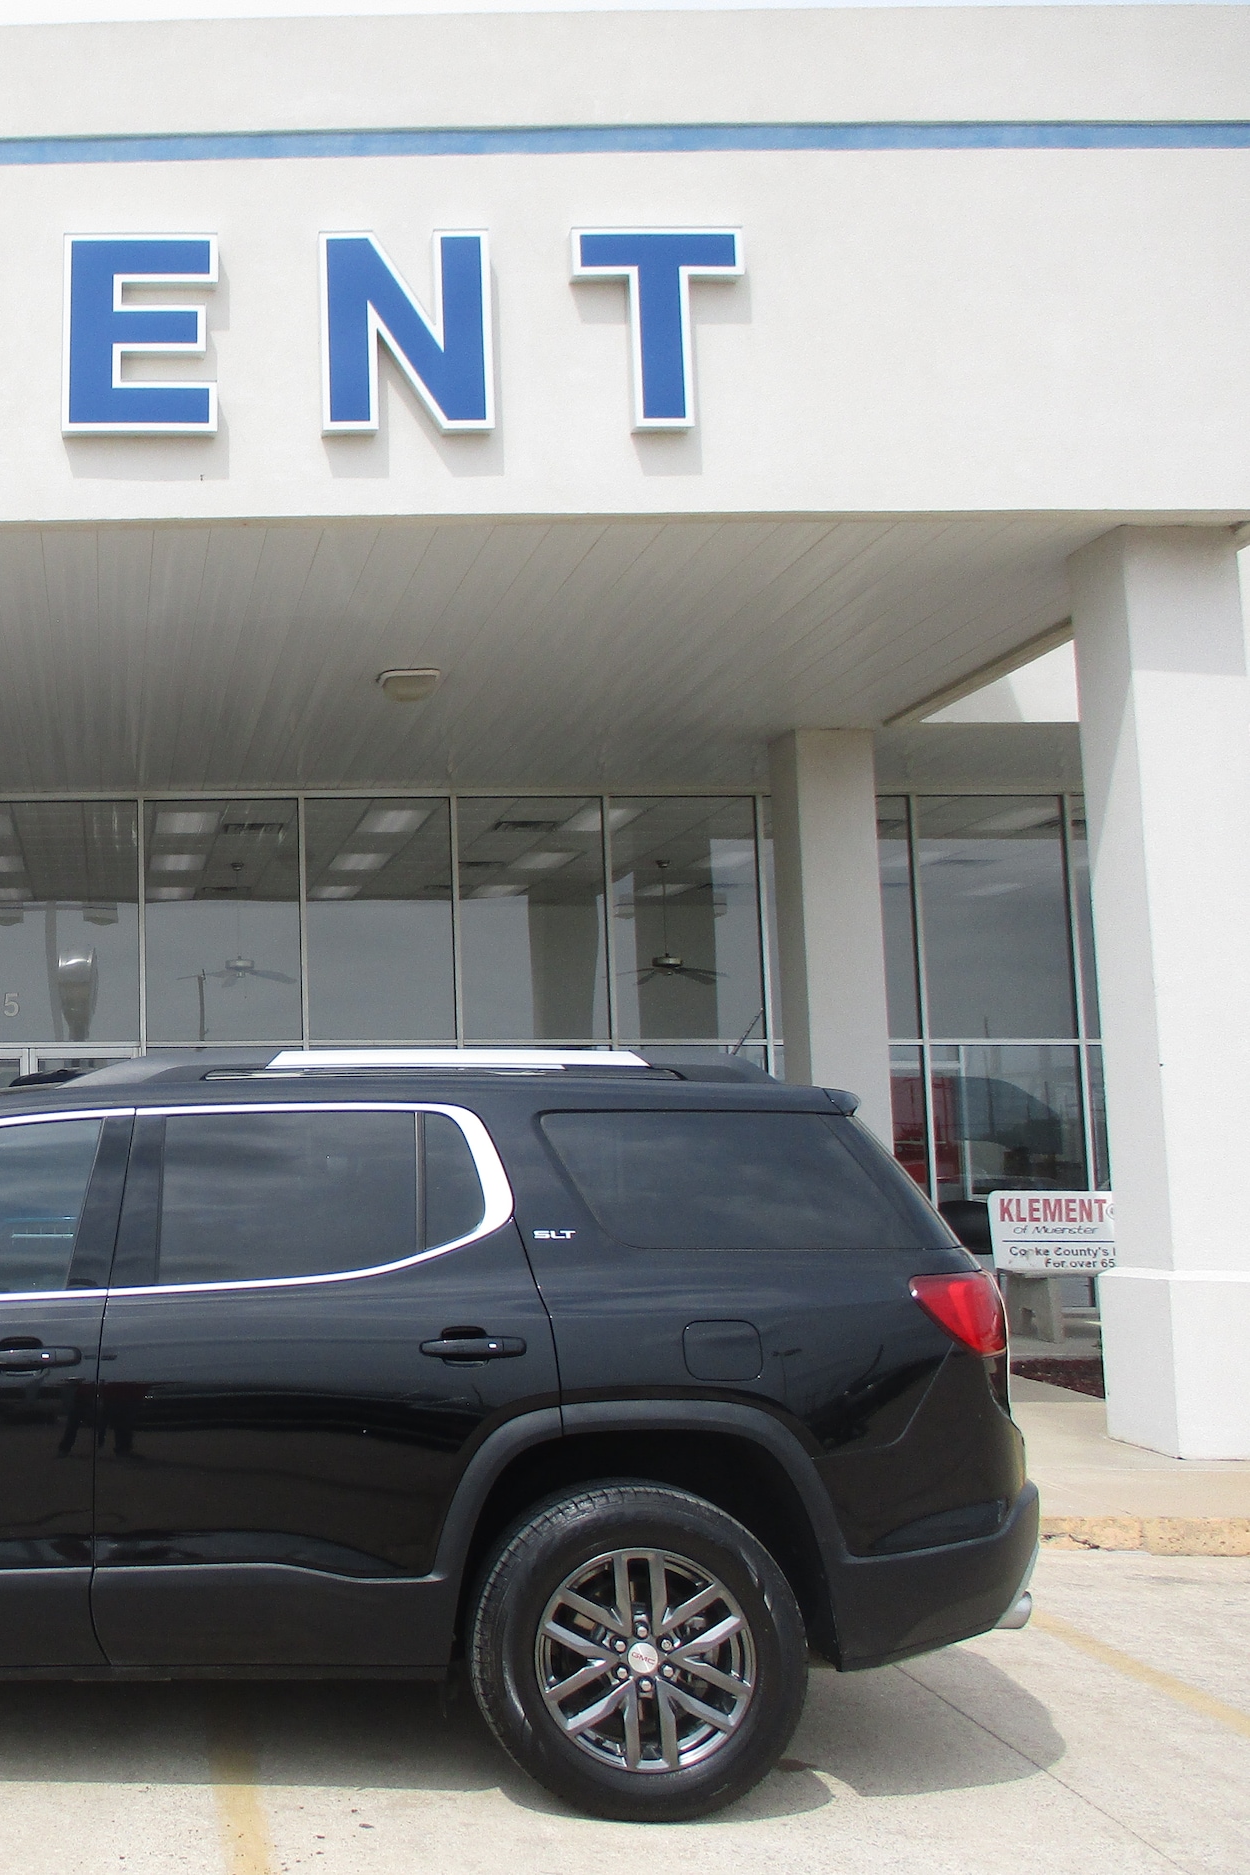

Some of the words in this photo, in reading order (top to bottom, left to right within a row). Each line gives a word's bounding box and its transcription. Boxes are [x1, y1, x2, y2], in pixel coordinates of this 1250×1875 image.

[999, 1198, 1107, 1223] KLEMENT
[533, 1230, 577, 1239] SLT
[1013, 1225, 1029, 1234] of
[1032, 1225, 1099, 1234] Muenster
[1053, 1246, 1109, 1258] County's
[1069, 1259, 1097, 1268] over
[631, 1651, 656, 1665] GMC
